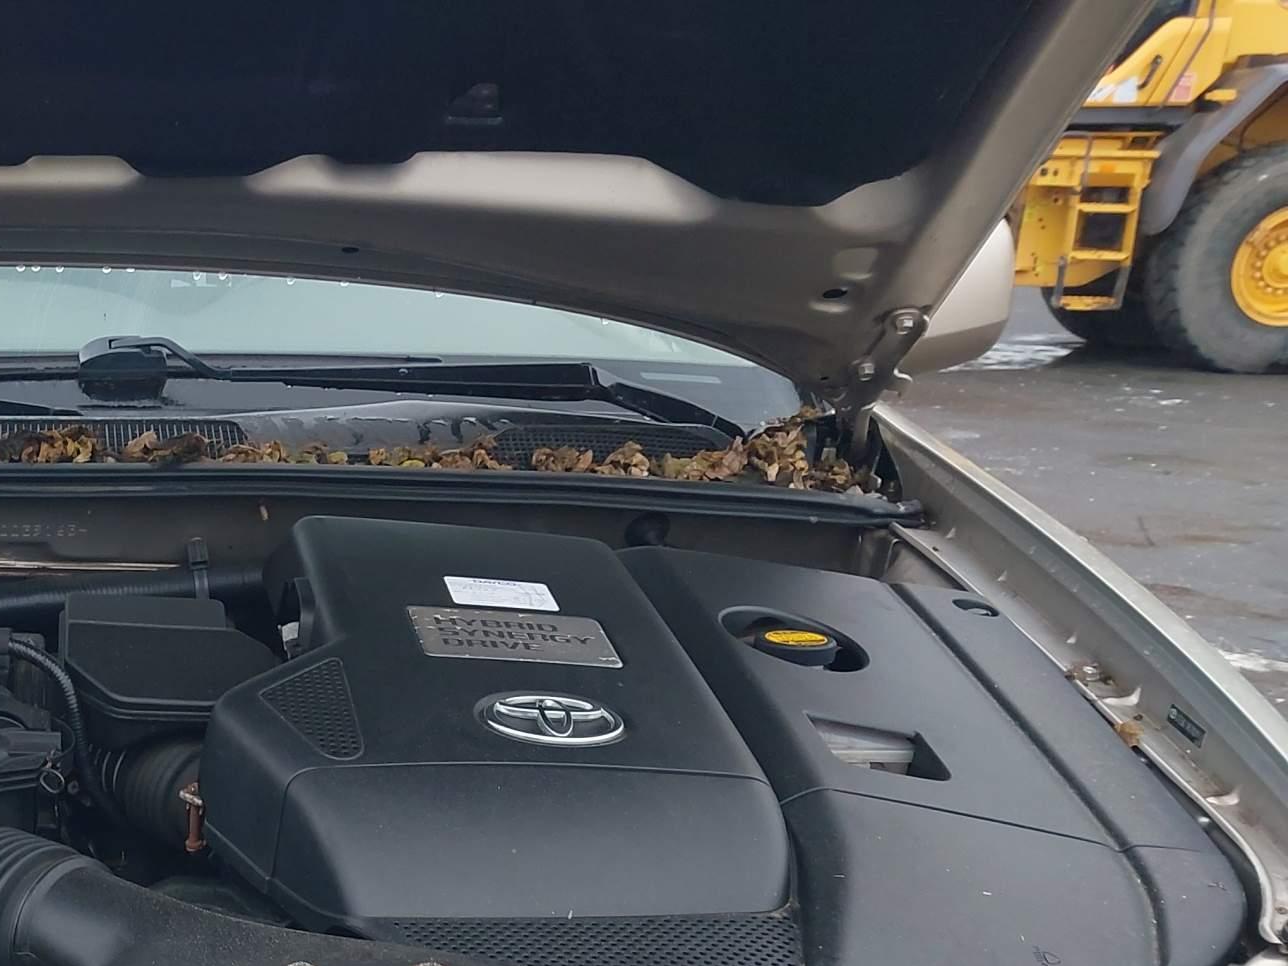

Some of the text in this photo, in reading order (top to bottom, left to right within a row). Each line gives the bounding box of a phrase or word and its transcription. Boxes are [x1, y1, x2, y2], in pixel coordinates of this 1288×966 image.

[433, 615, 558, 633] HYBRID
[436, 626, 594, 645] SYNERGY
[442, 637, 543, 651] DRIVE
